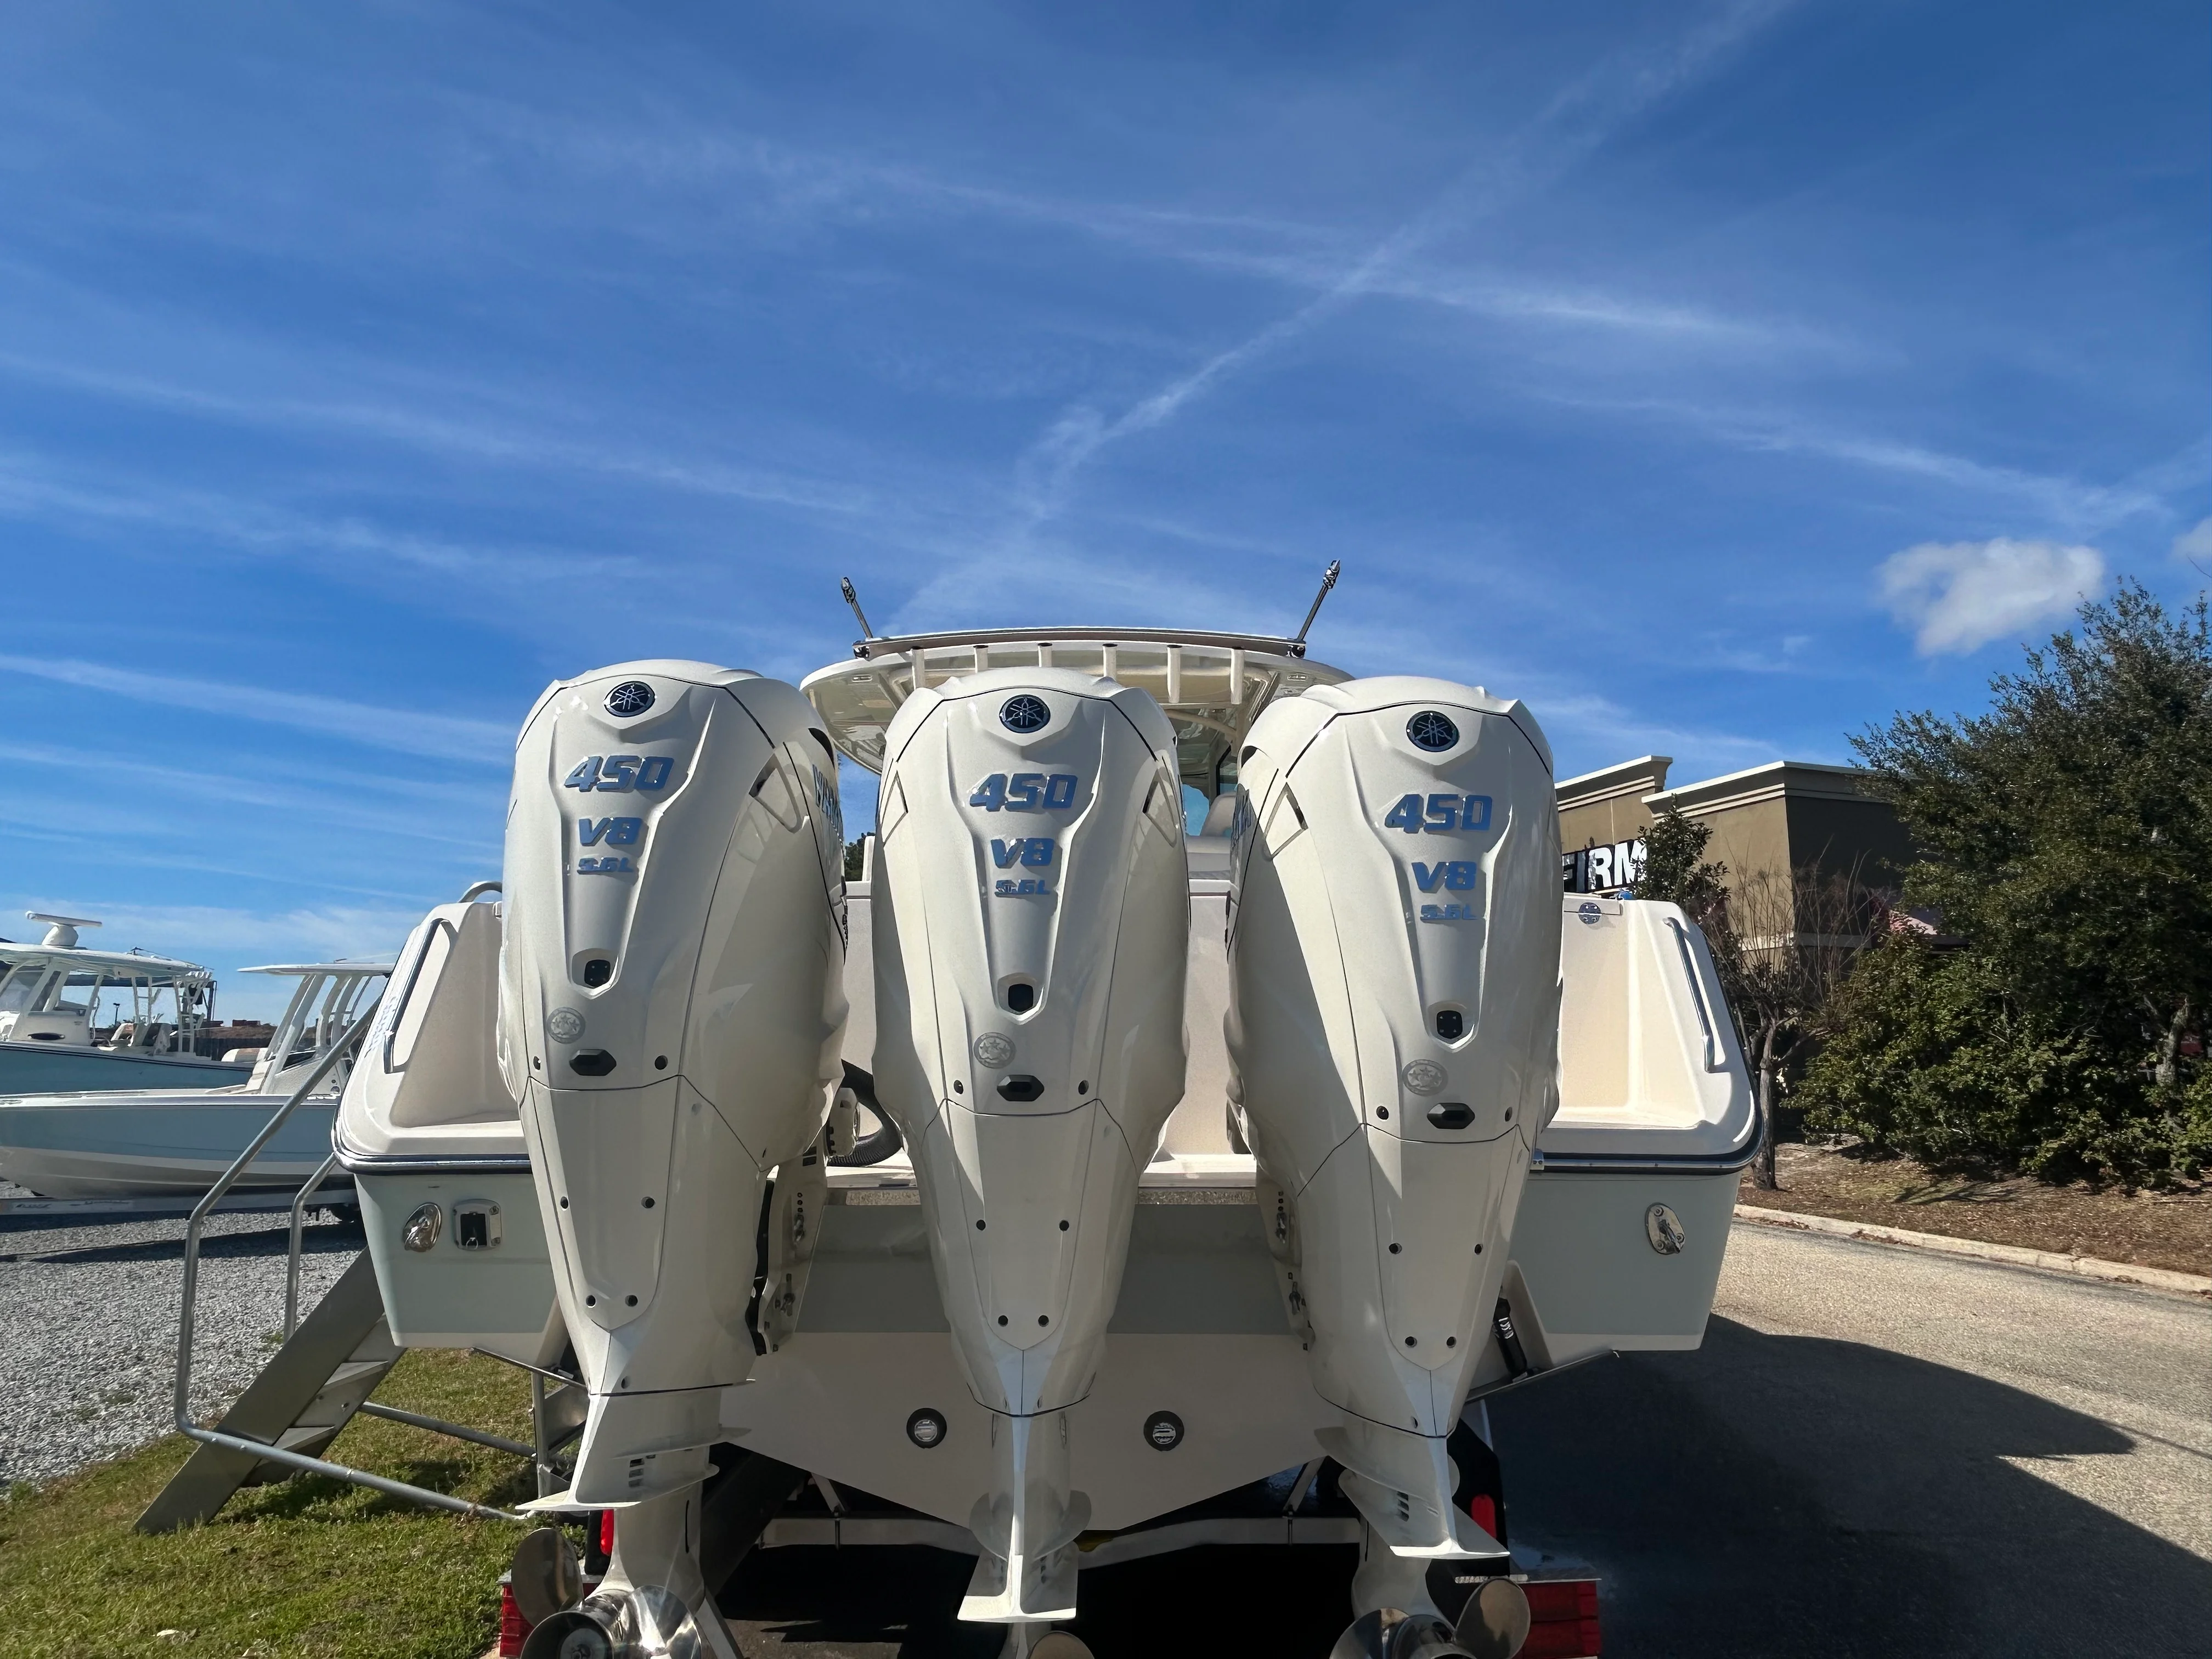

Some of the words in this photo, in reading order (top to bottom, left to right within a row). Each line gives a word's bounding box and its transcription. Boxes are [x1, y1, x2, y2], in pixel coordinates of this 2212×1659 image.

[564, 755, 674, 793] 450
[969, 773, 1078, 812] 450
[1385, 794, 1492, 834] 450
[579, 817, 643, 847] V8
[991, 838, 1054, 868] V8
[1412, 861, 1477, 893] V8
